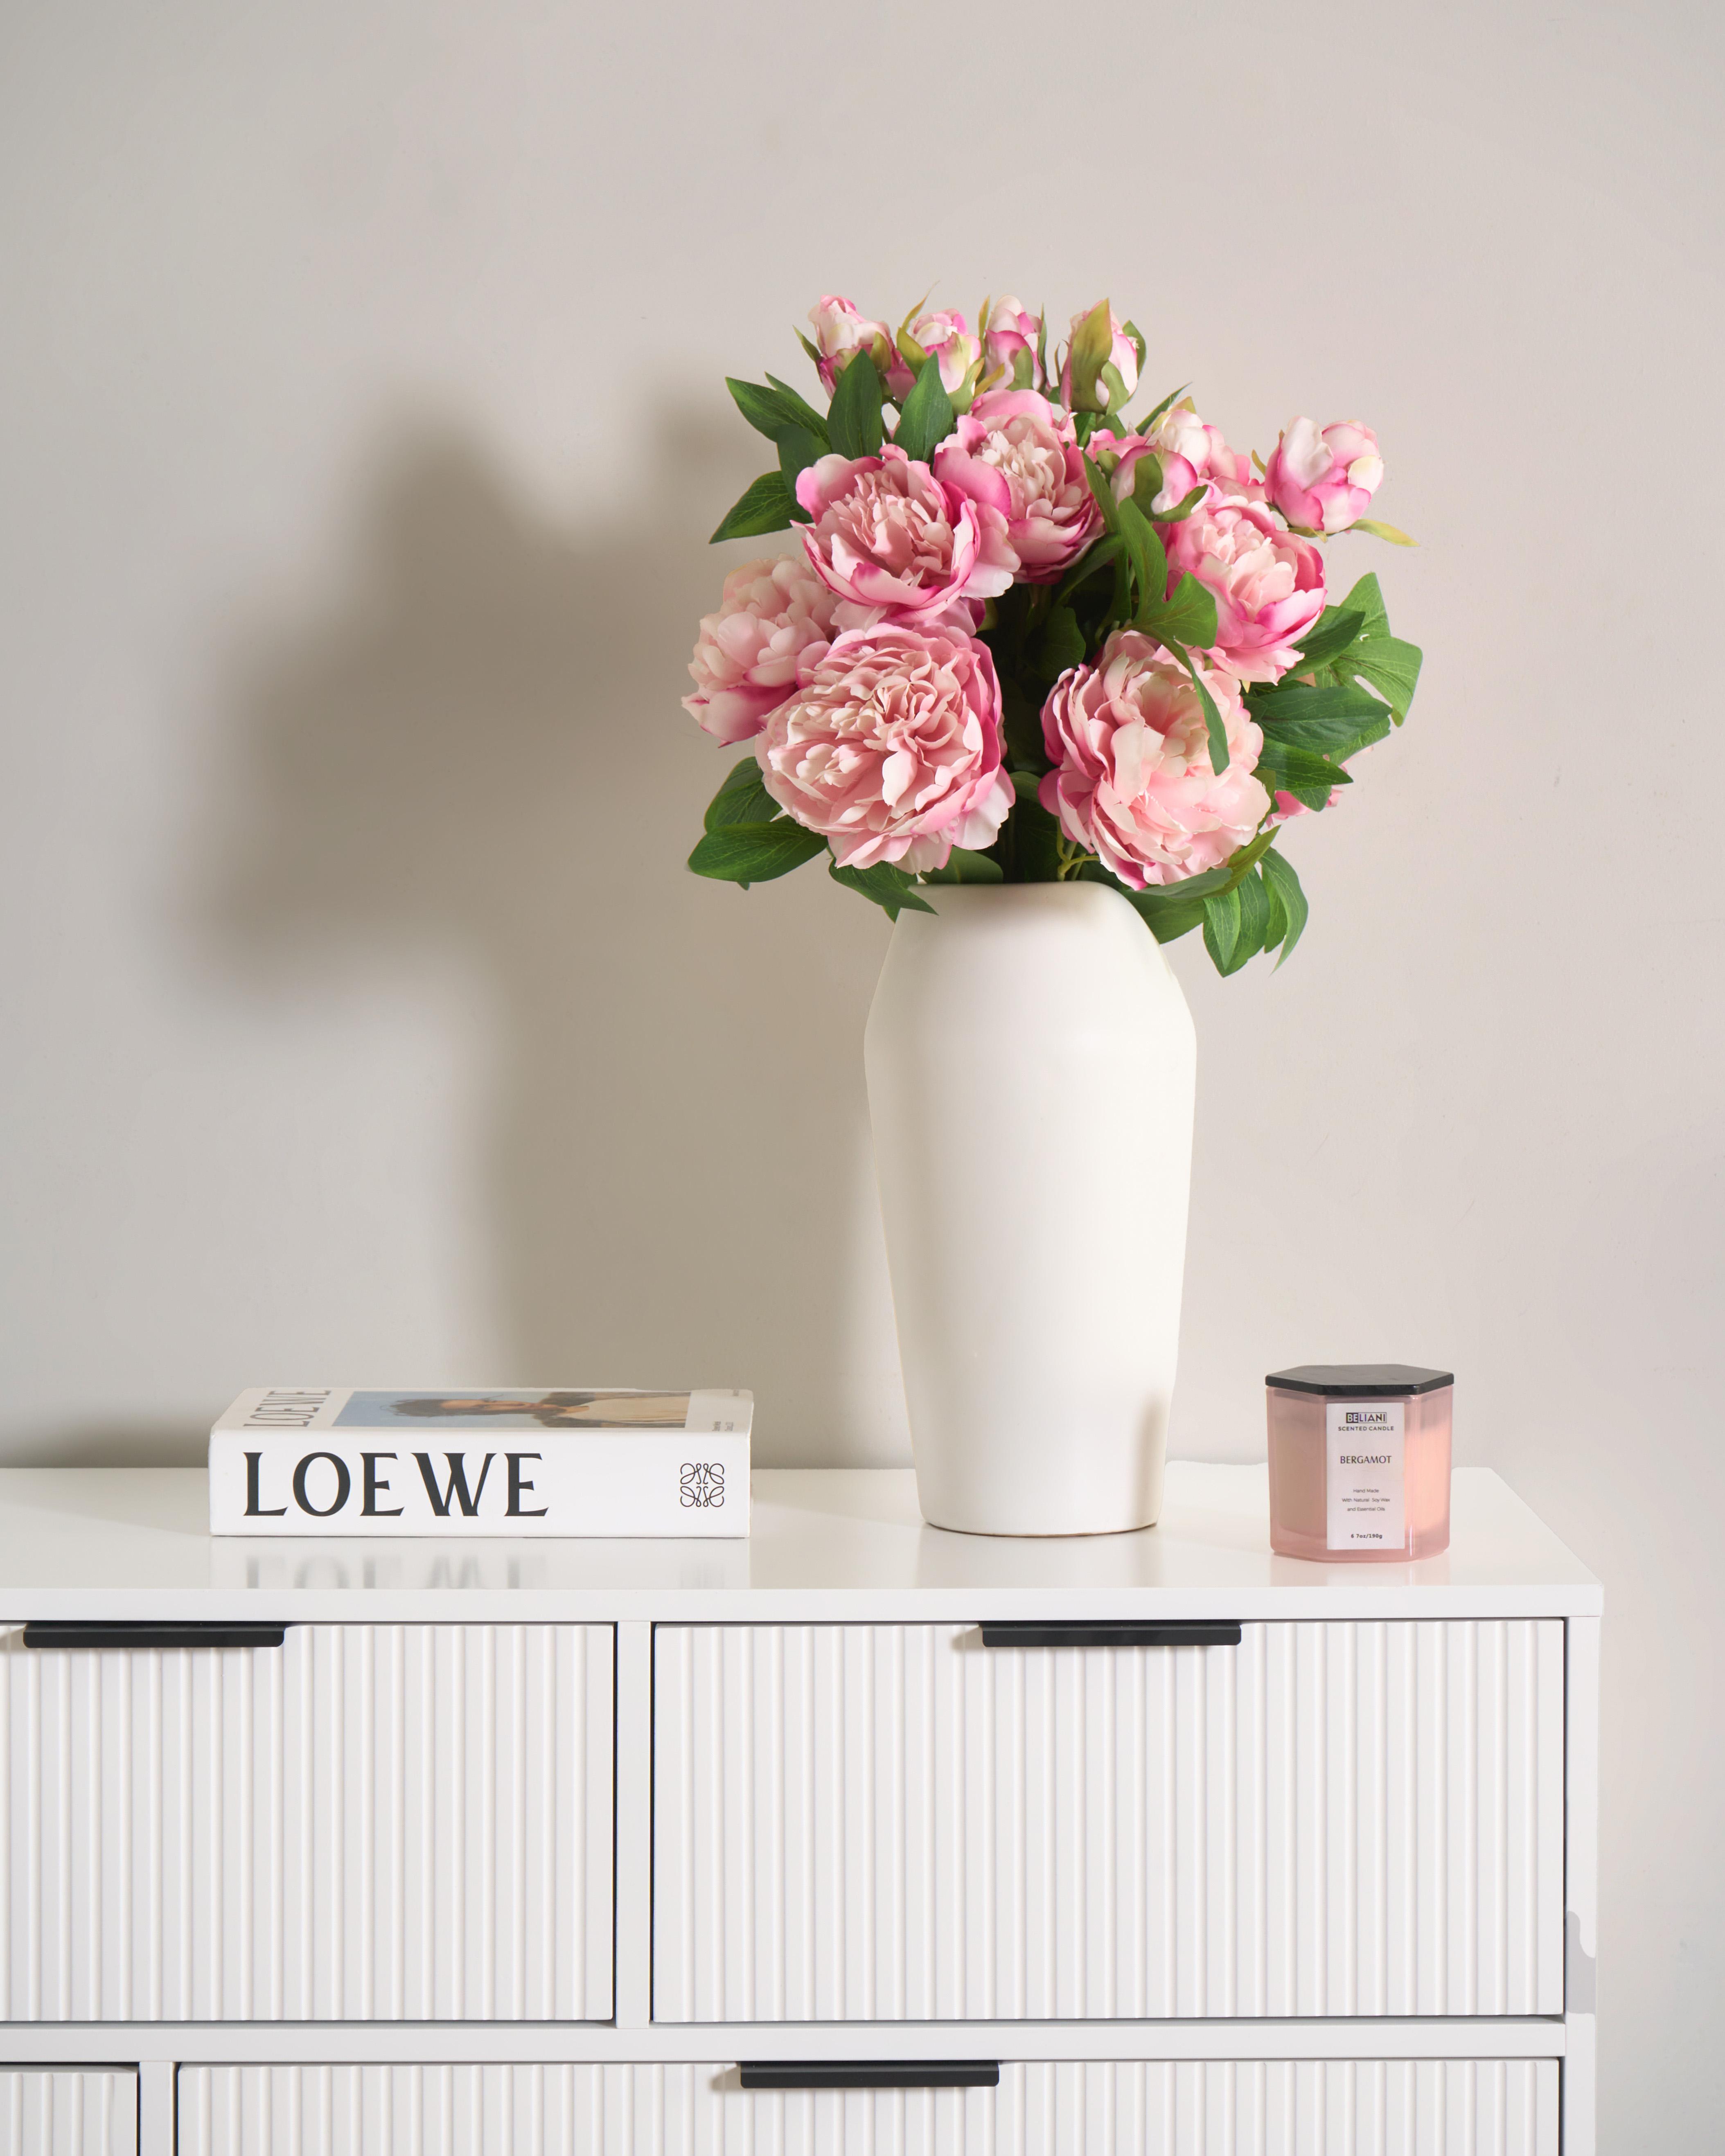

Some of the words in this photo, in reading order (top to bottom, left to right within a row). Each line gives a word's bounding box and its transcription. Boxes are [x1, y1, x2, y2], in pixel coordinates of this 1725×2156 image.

[243, 1390, 331, 1427] LOEWE
[1347, 1413, 1386, 1422] BELIANI
[1340, 1455, 1391, 1464] BERGAMOT
[243, 1452, 549, 1516] LOEWE
